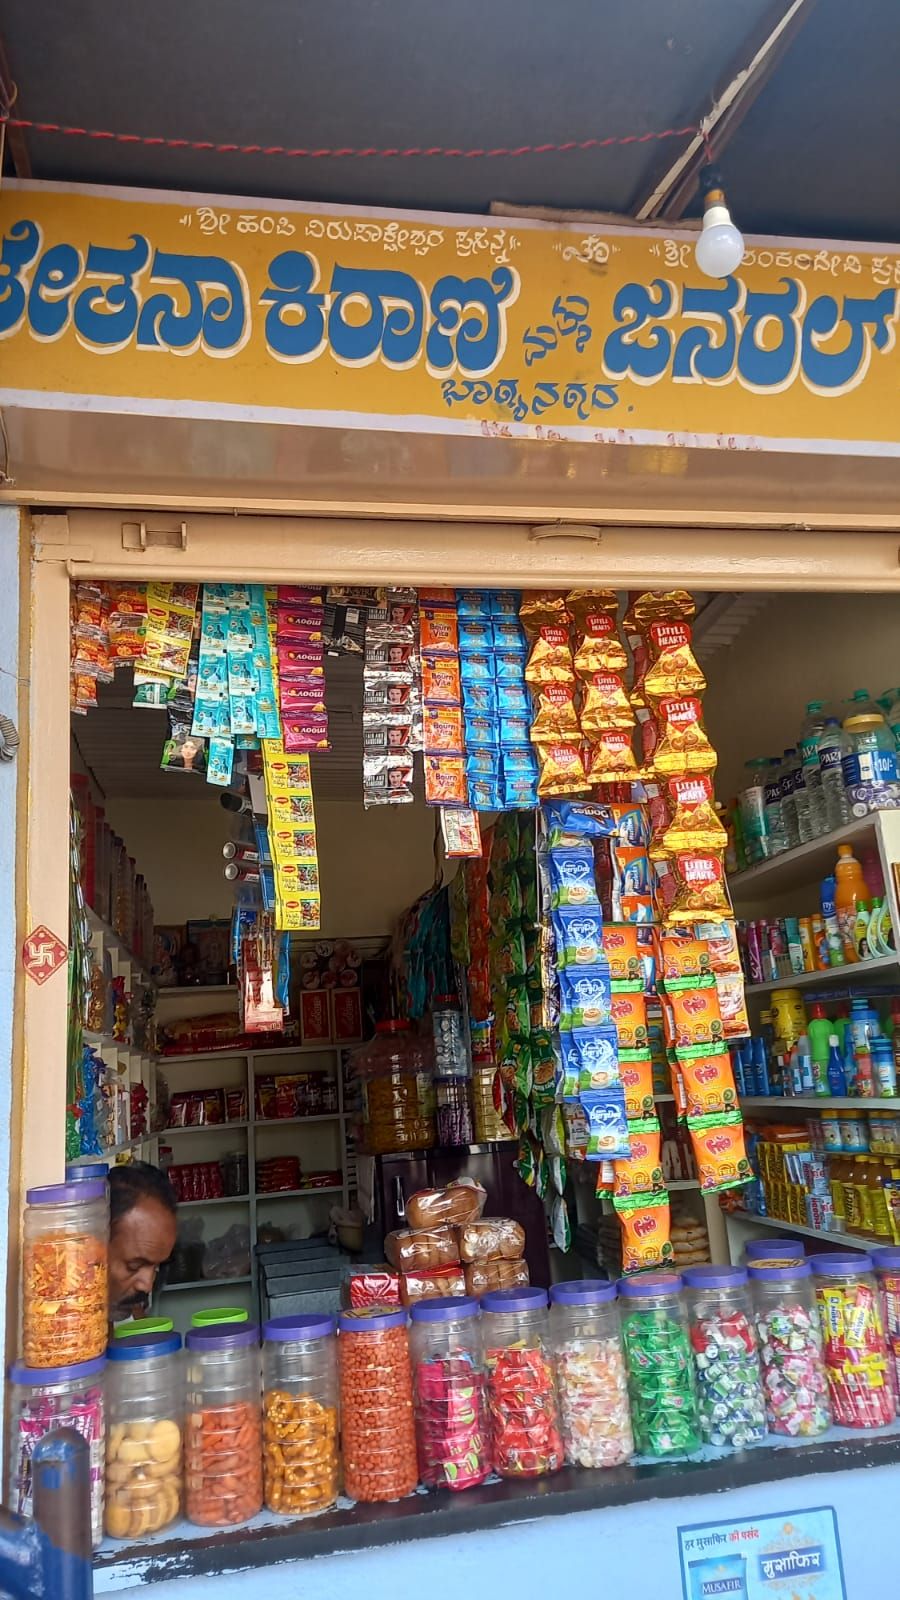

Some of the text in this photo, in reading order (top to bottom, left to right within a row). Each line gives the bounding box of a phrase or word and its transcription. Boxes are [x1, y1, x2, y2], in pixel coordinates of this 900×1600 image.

[196, 207, 231, 235] ಶ್ರೀ
[236, 215, 296, 236] ಹಂಪಿ
[664, 239, 691, 268] ಶ್ರೀ
[601, 275, 898, 397] ಜನರಲ್
[656, 626, 685, 637] LITTLE
[658, 635, 687, 646] HEARTS
[666, 701, 695, 713] LITTLE
[667, 711, 697, 722] HEARTS
[675, 780, 704, 792] LITTLE
[677, 790, 708, 801] HEARTS
[684, 860, 714, 871] LITTLE
[685, 870, 716, 881] HEARTS
[702, 1579, 742, 1594] MUSAFIR
